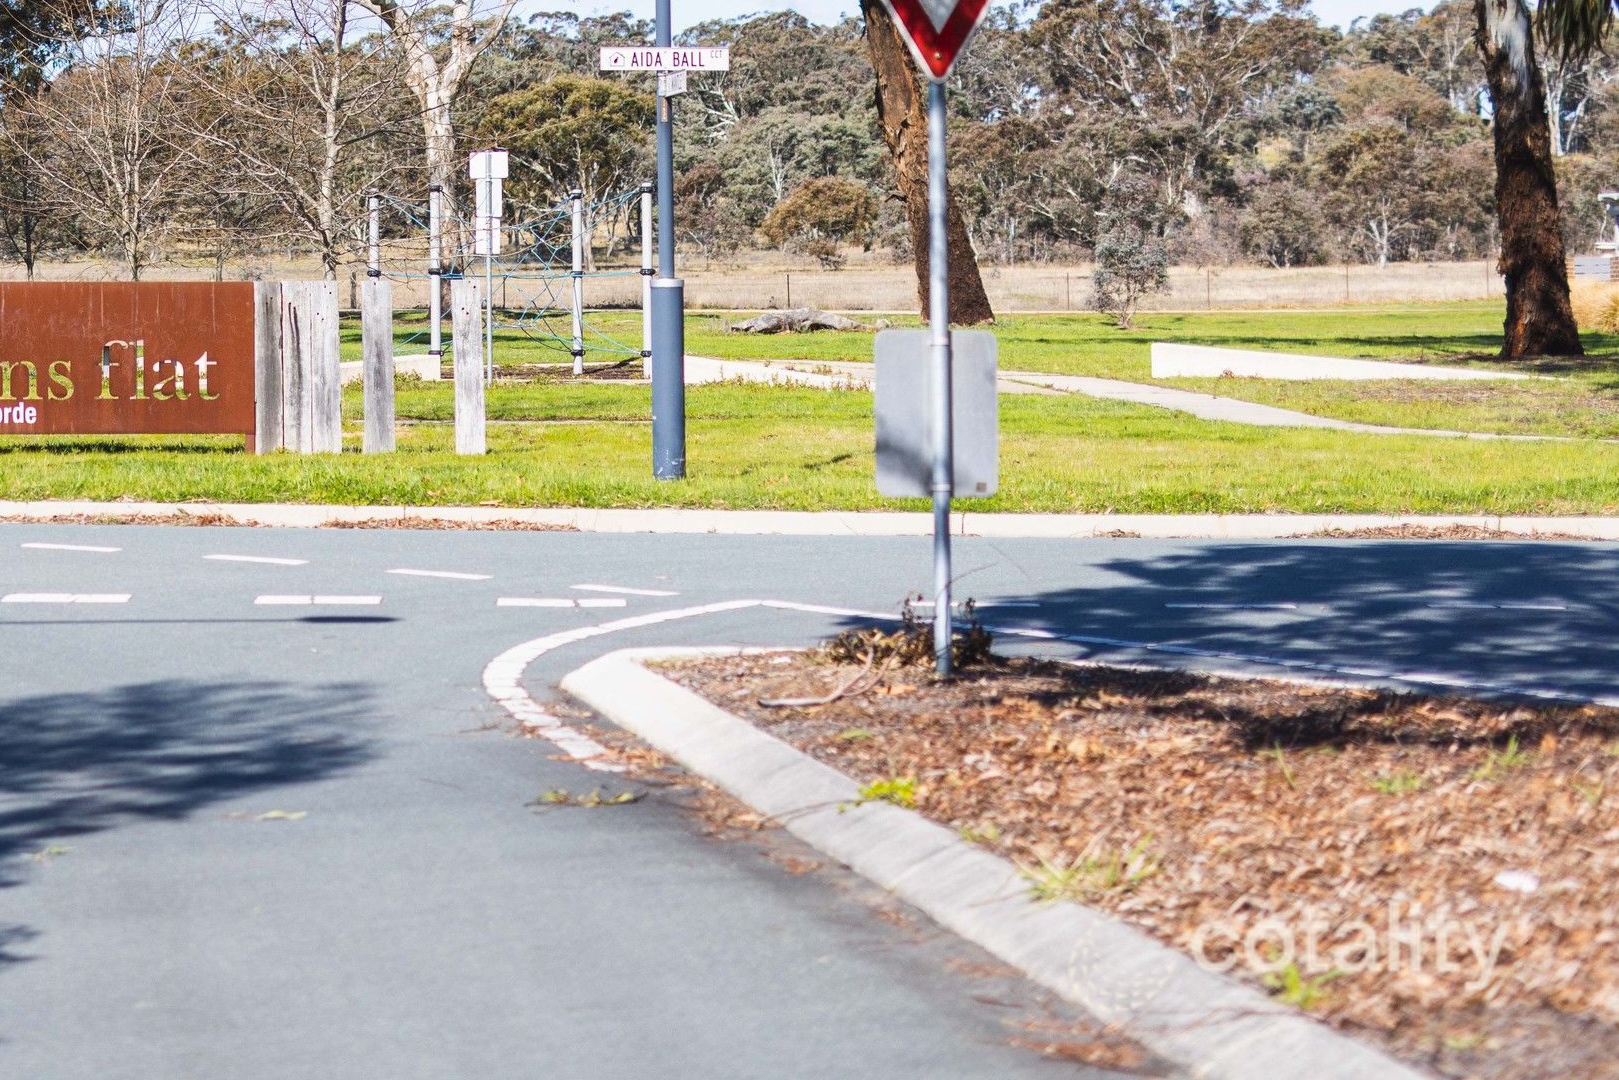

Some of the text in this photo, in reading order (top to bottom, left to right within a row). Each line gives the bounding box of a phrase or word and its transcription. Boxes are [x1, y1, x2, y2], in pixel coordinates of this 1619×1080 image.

[631, 52, 662, 66] AIDA
[673, 52, 704, 66] BALL
[94, 339, 220, 401] flat
